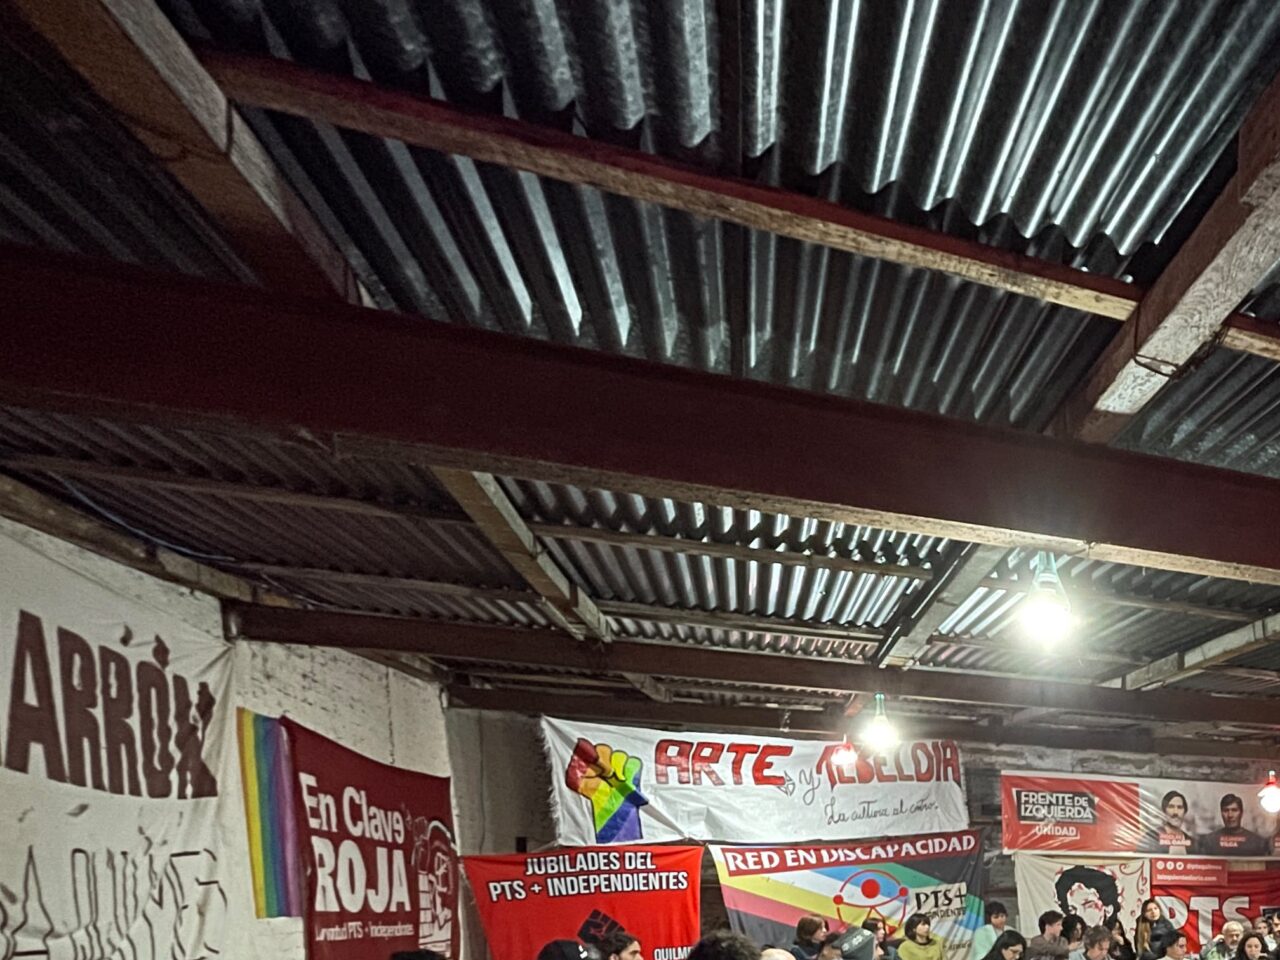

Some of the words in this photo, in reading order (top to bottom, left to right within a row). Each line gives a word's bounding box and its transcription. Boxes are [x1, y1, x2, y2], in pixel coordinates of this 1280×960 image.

[654, 739, 794, 786] ARTE
[298, 771, 338, 833] En
[342, 785, 406, 845] Clave
[1020, 791, 1073, 806] FRENTE
[1074, 796, 1089, 807] DE
[1020, 803, 1093, 819] IZQUIERDA
[1035, 825, 1077, 836] UNIDAD
[525, 851, 621, 876] JUBILADES
[624, 851, 657, 870] DEL
[726, 849, 780, 872] RED
[785, 848, 817, 868] EN
[821, 835, 976, 864] DISCAPACIDAD
[310, 834, 413, 914] ROJA
[488, 880, 526, 902] PTS
[530, 883, 542, 894] +
[546, 871, 688, 897] INDEPENDIENTES
[1153, 895, 1254, 946] PTS
